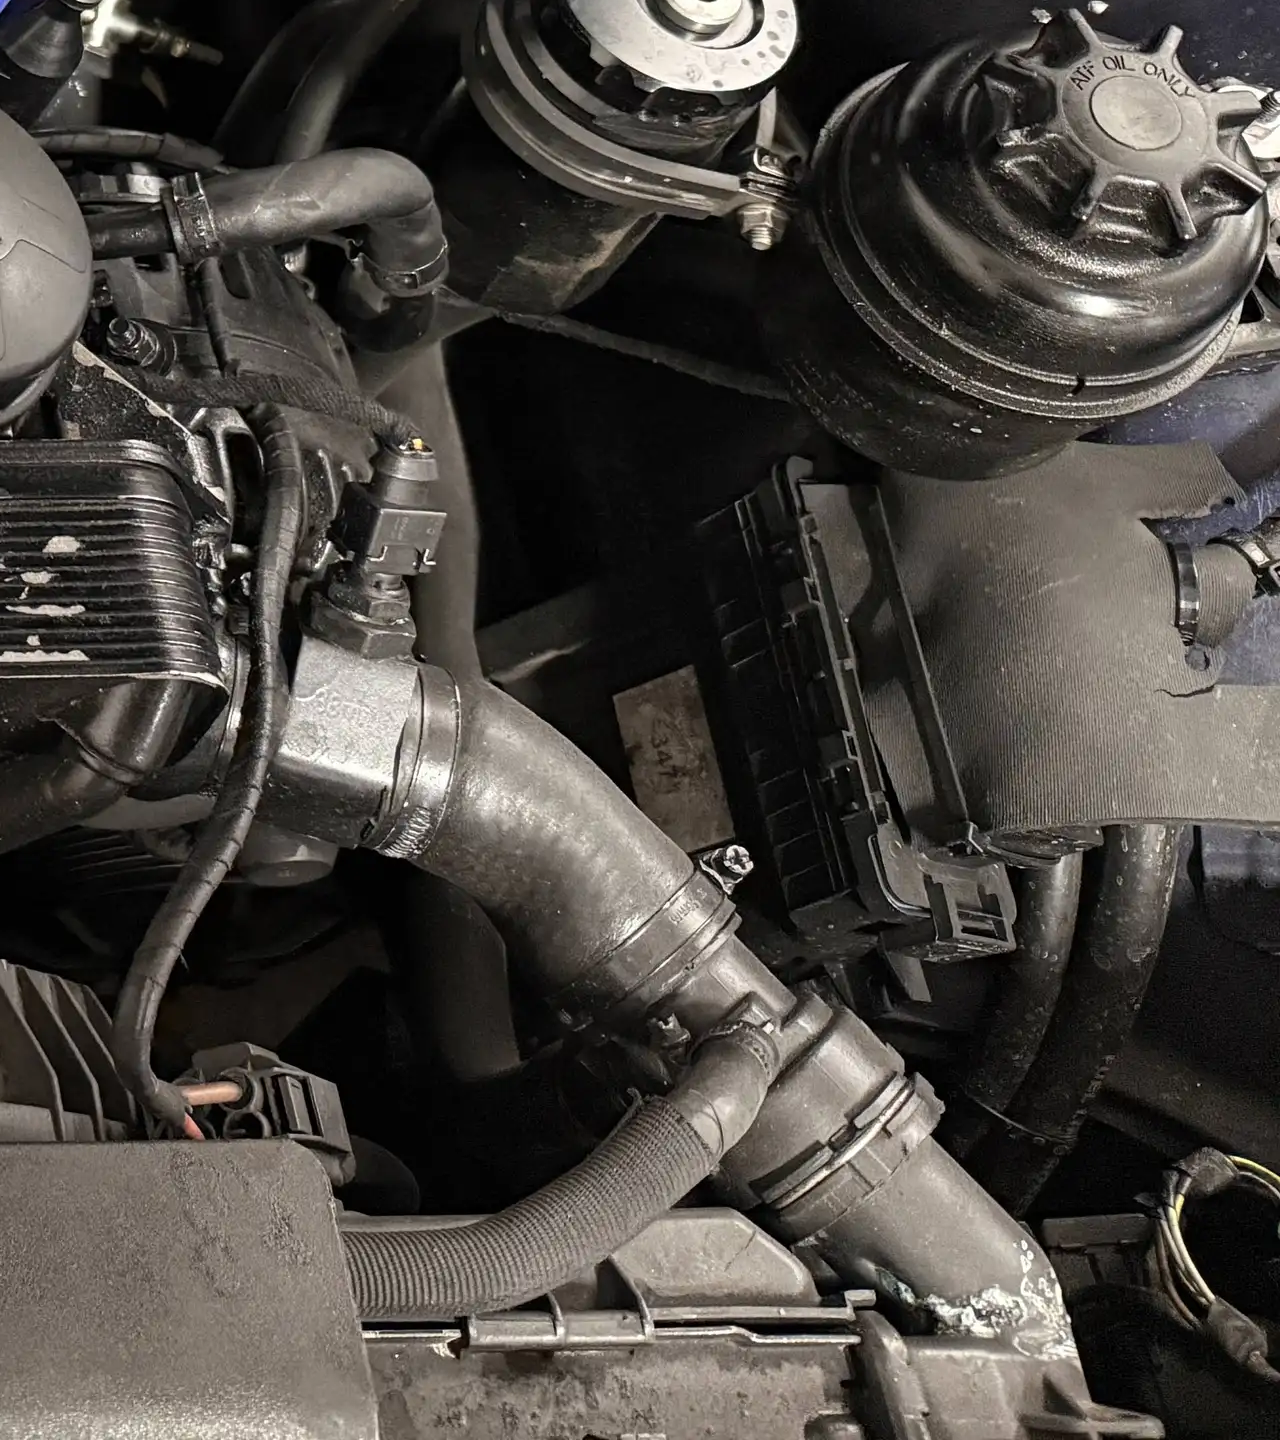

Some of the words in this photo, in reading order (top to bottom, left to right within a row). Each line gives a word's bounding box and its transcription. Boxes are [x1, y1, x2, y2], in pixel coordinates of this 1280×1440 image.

[1070, 60, 1095, 91] ATF
[1102, 55, 1136, 72] OIL
[1143, 62, 1196, 98] ONLY
